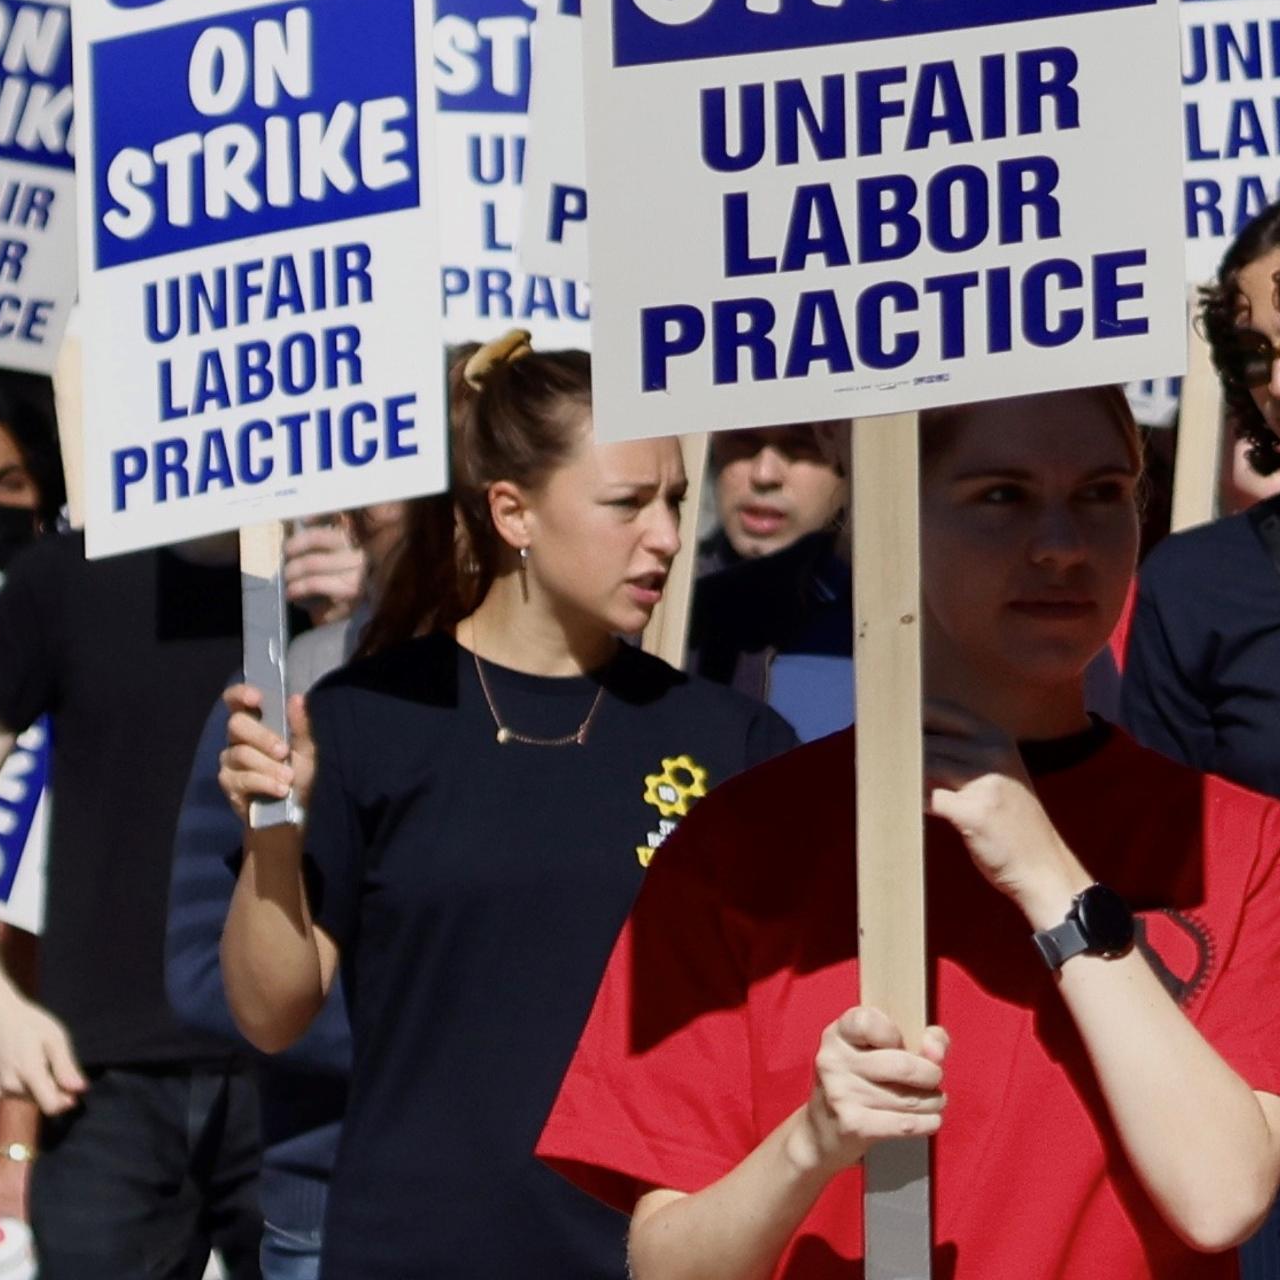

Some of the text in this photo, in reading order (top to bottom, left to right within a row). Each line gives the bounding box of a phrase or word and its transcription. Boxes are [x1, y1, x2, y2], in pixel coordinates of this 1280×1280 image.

[187, 7, 312, 116] ON
[698, 45, 1081, 174] UNFAIR
[102, 96, 410, 240] STRIKE
[721, 153, 1063, 279] LABOR
[141, 240, 375, 345] UNFAIR
[639, 247, 1150, 395] PRACTICE
[155, 324, 364, 424] LABOR
[109, 391, 420, 514] PRACTICE
